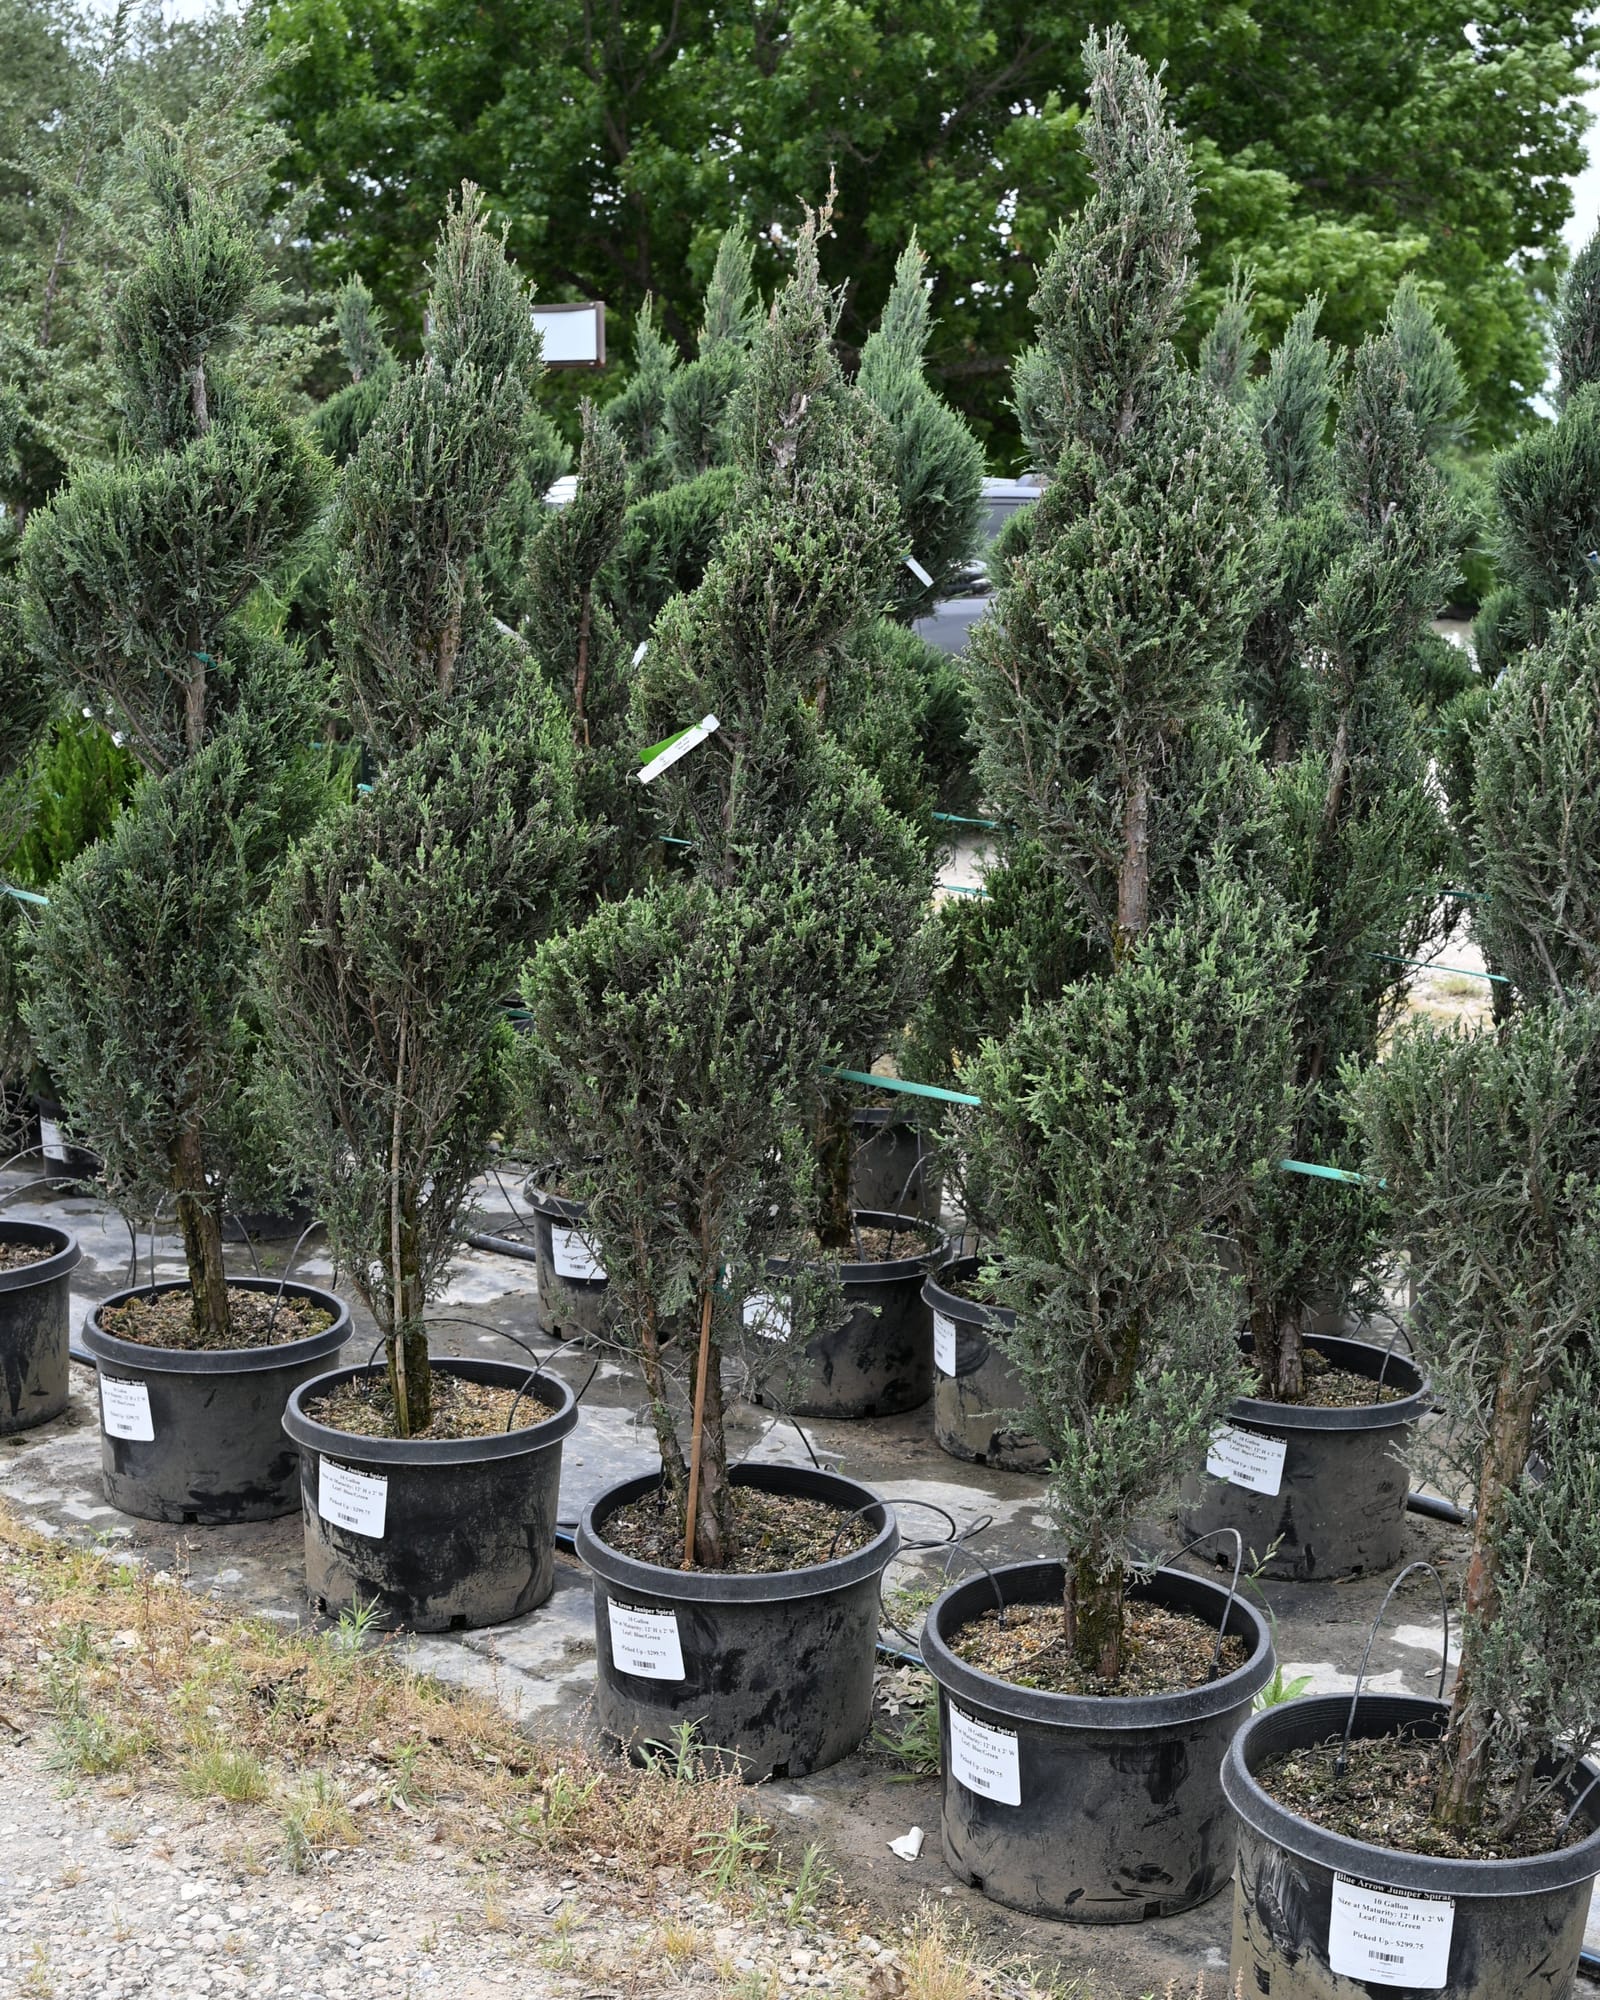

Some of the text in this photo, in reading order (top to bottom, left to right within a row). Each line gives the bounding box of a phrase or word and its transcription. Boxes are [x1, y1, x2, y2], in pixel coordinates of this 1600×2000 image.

[1248, 1428, 1268, 1439] Juniper
[347, 1466, 368, 1477] Juniper
[369, 1472, 387, 1481] Spiral
[634, 1605, 654, 1614] Juniper
[974, 1717, 996, 1731] Juniper
[997, 1726, 1017, 1737] Spiral
[1337, 1872, 1355, 1885] Blue
[1358, 1880, 1385, 1892] Arrow
[1387, 1886, 1422, 1898] Juniper
[1338, 1897, 1351, 1906] Size
[1362, 1904, 1397, 1918] Maturity:
[1384, 1901, 1409, 1910] Gallon
[1359, 1912, 1421, 1930] Leaf: Blue/Green
[1353, 1930, 1376, 1942] Picked
[1396, 1941, 1424, 1950] $299.75
